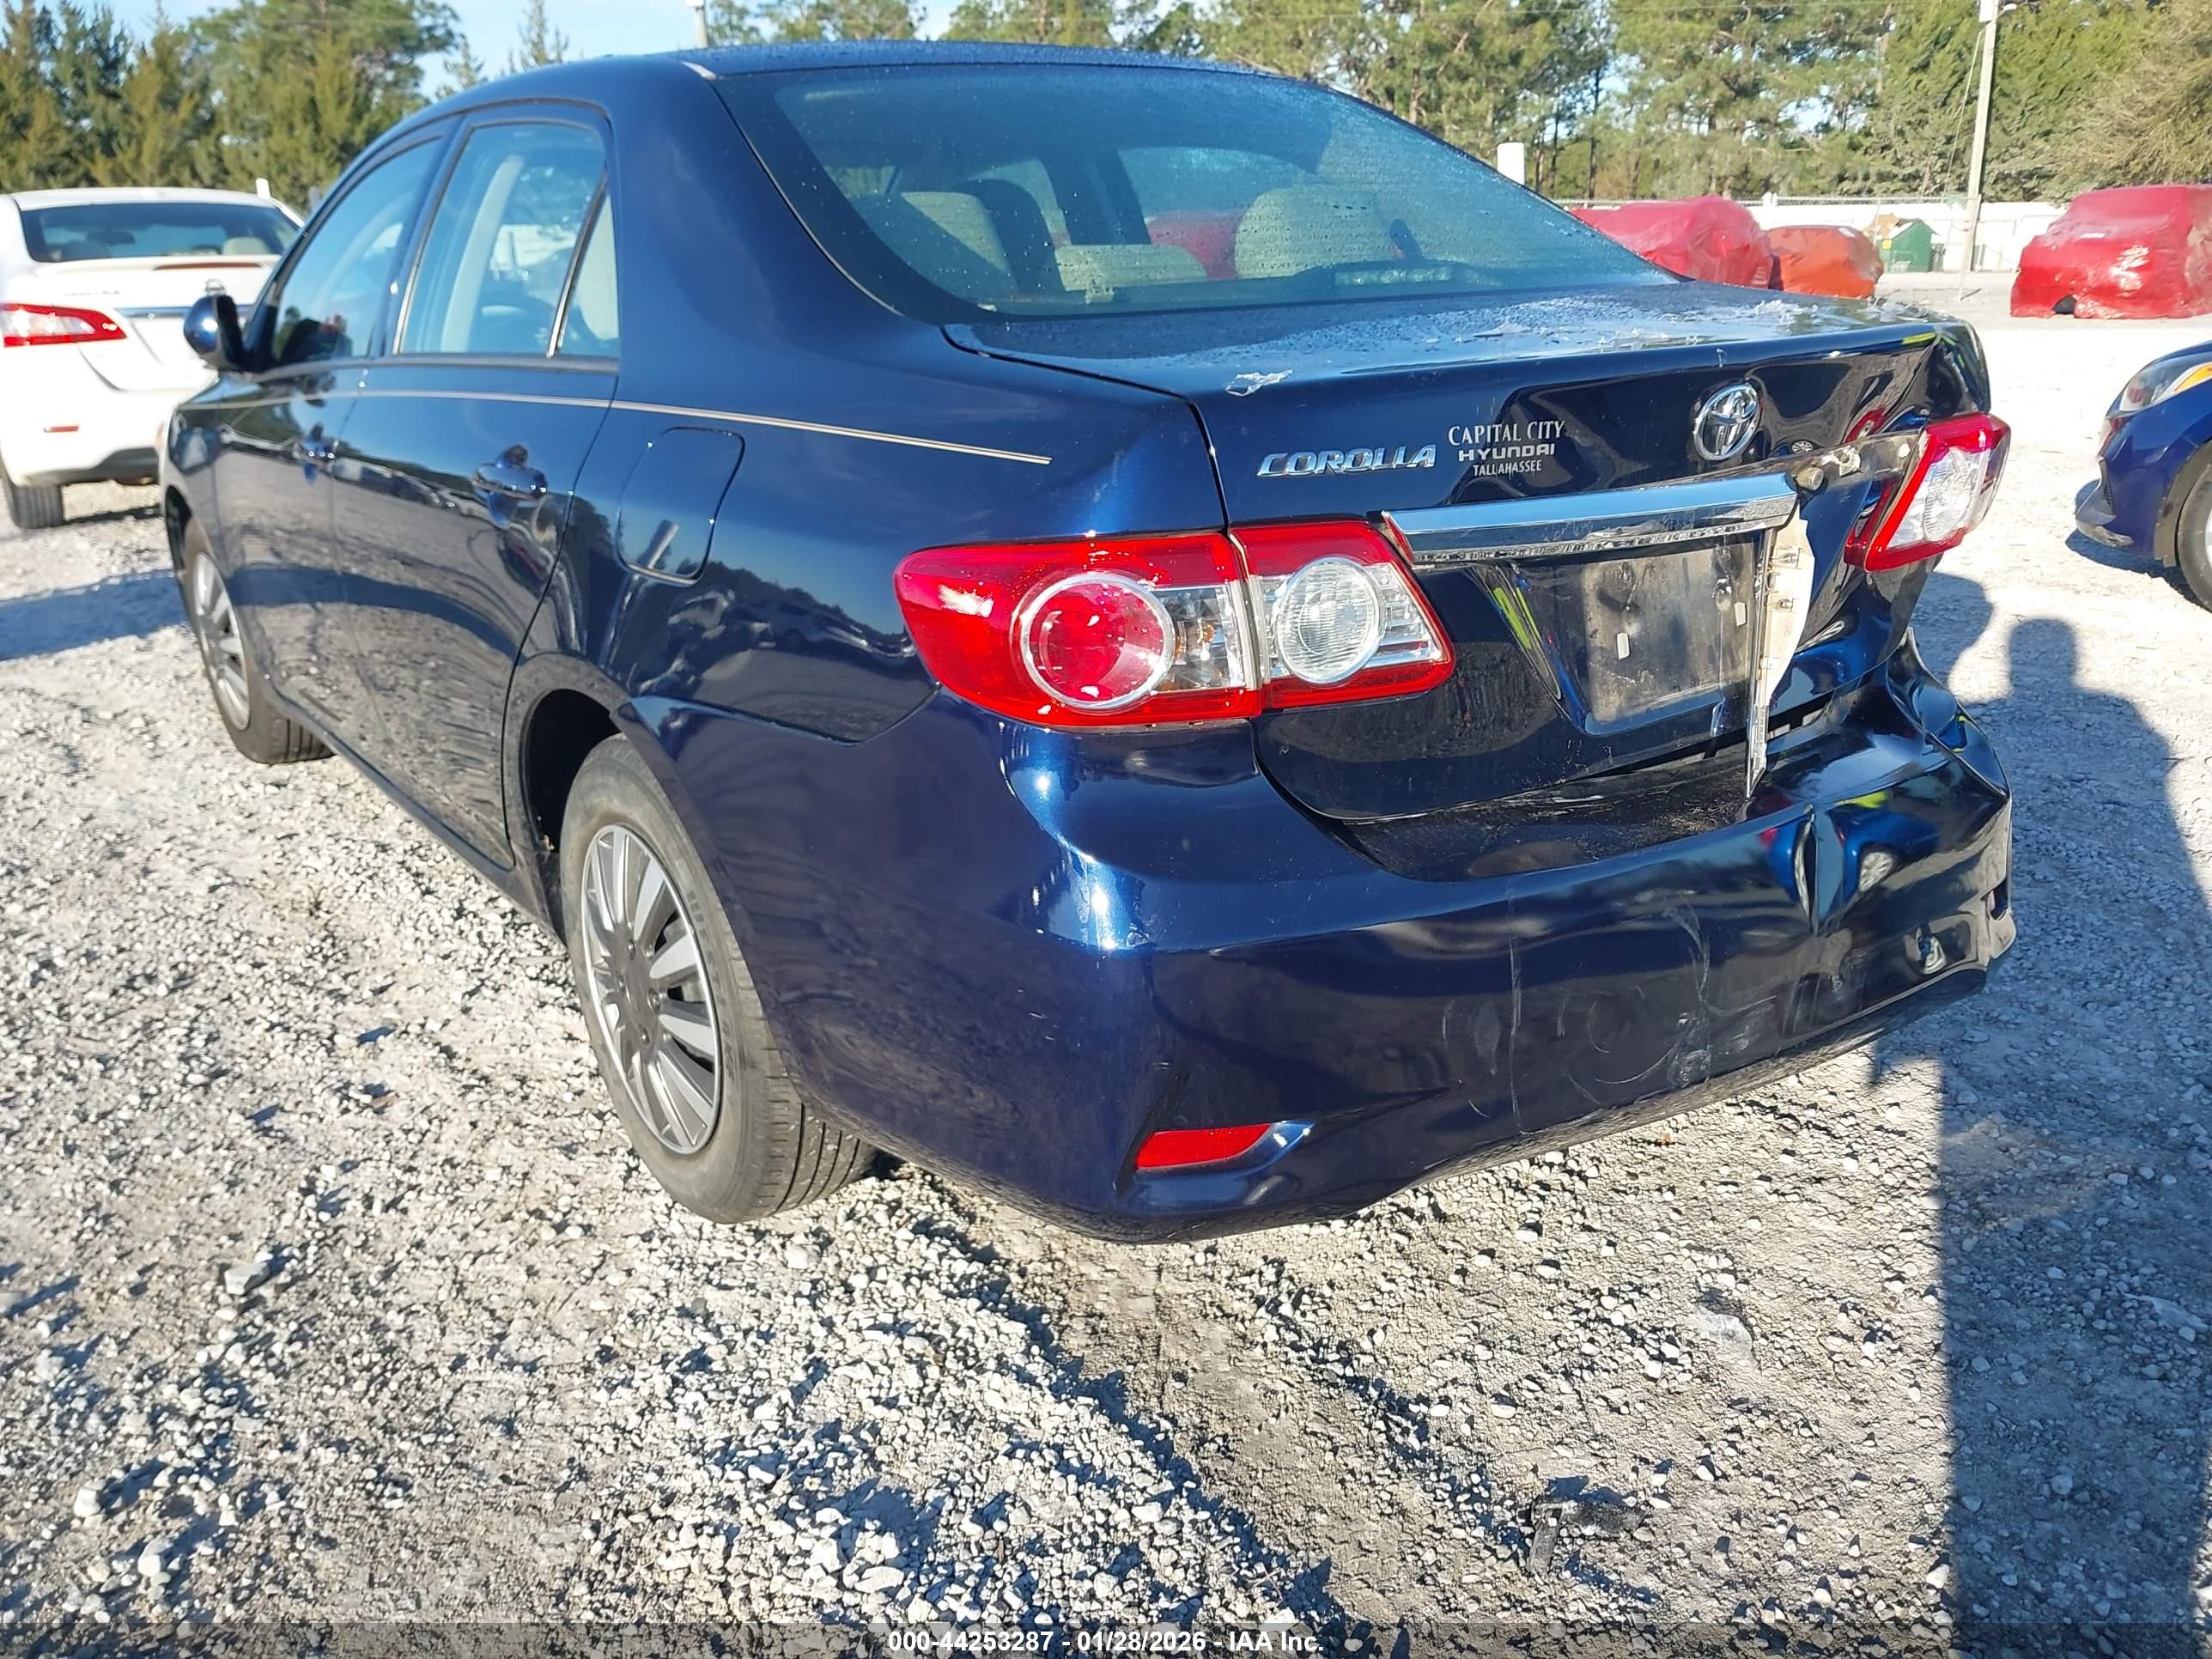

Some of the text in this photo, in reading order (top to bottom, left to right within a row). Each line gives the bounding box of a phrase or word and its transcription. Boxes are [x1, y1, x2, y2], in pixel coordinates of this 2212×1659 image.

[1448, 421, 1565, 446] CAPITAL CITY
[1256, 444, 1437, 477] COROLLA
[1458, 443, 1555, 462] HYUNDAI
[1473, 459, 1542, 477] TALLAHASSEE
